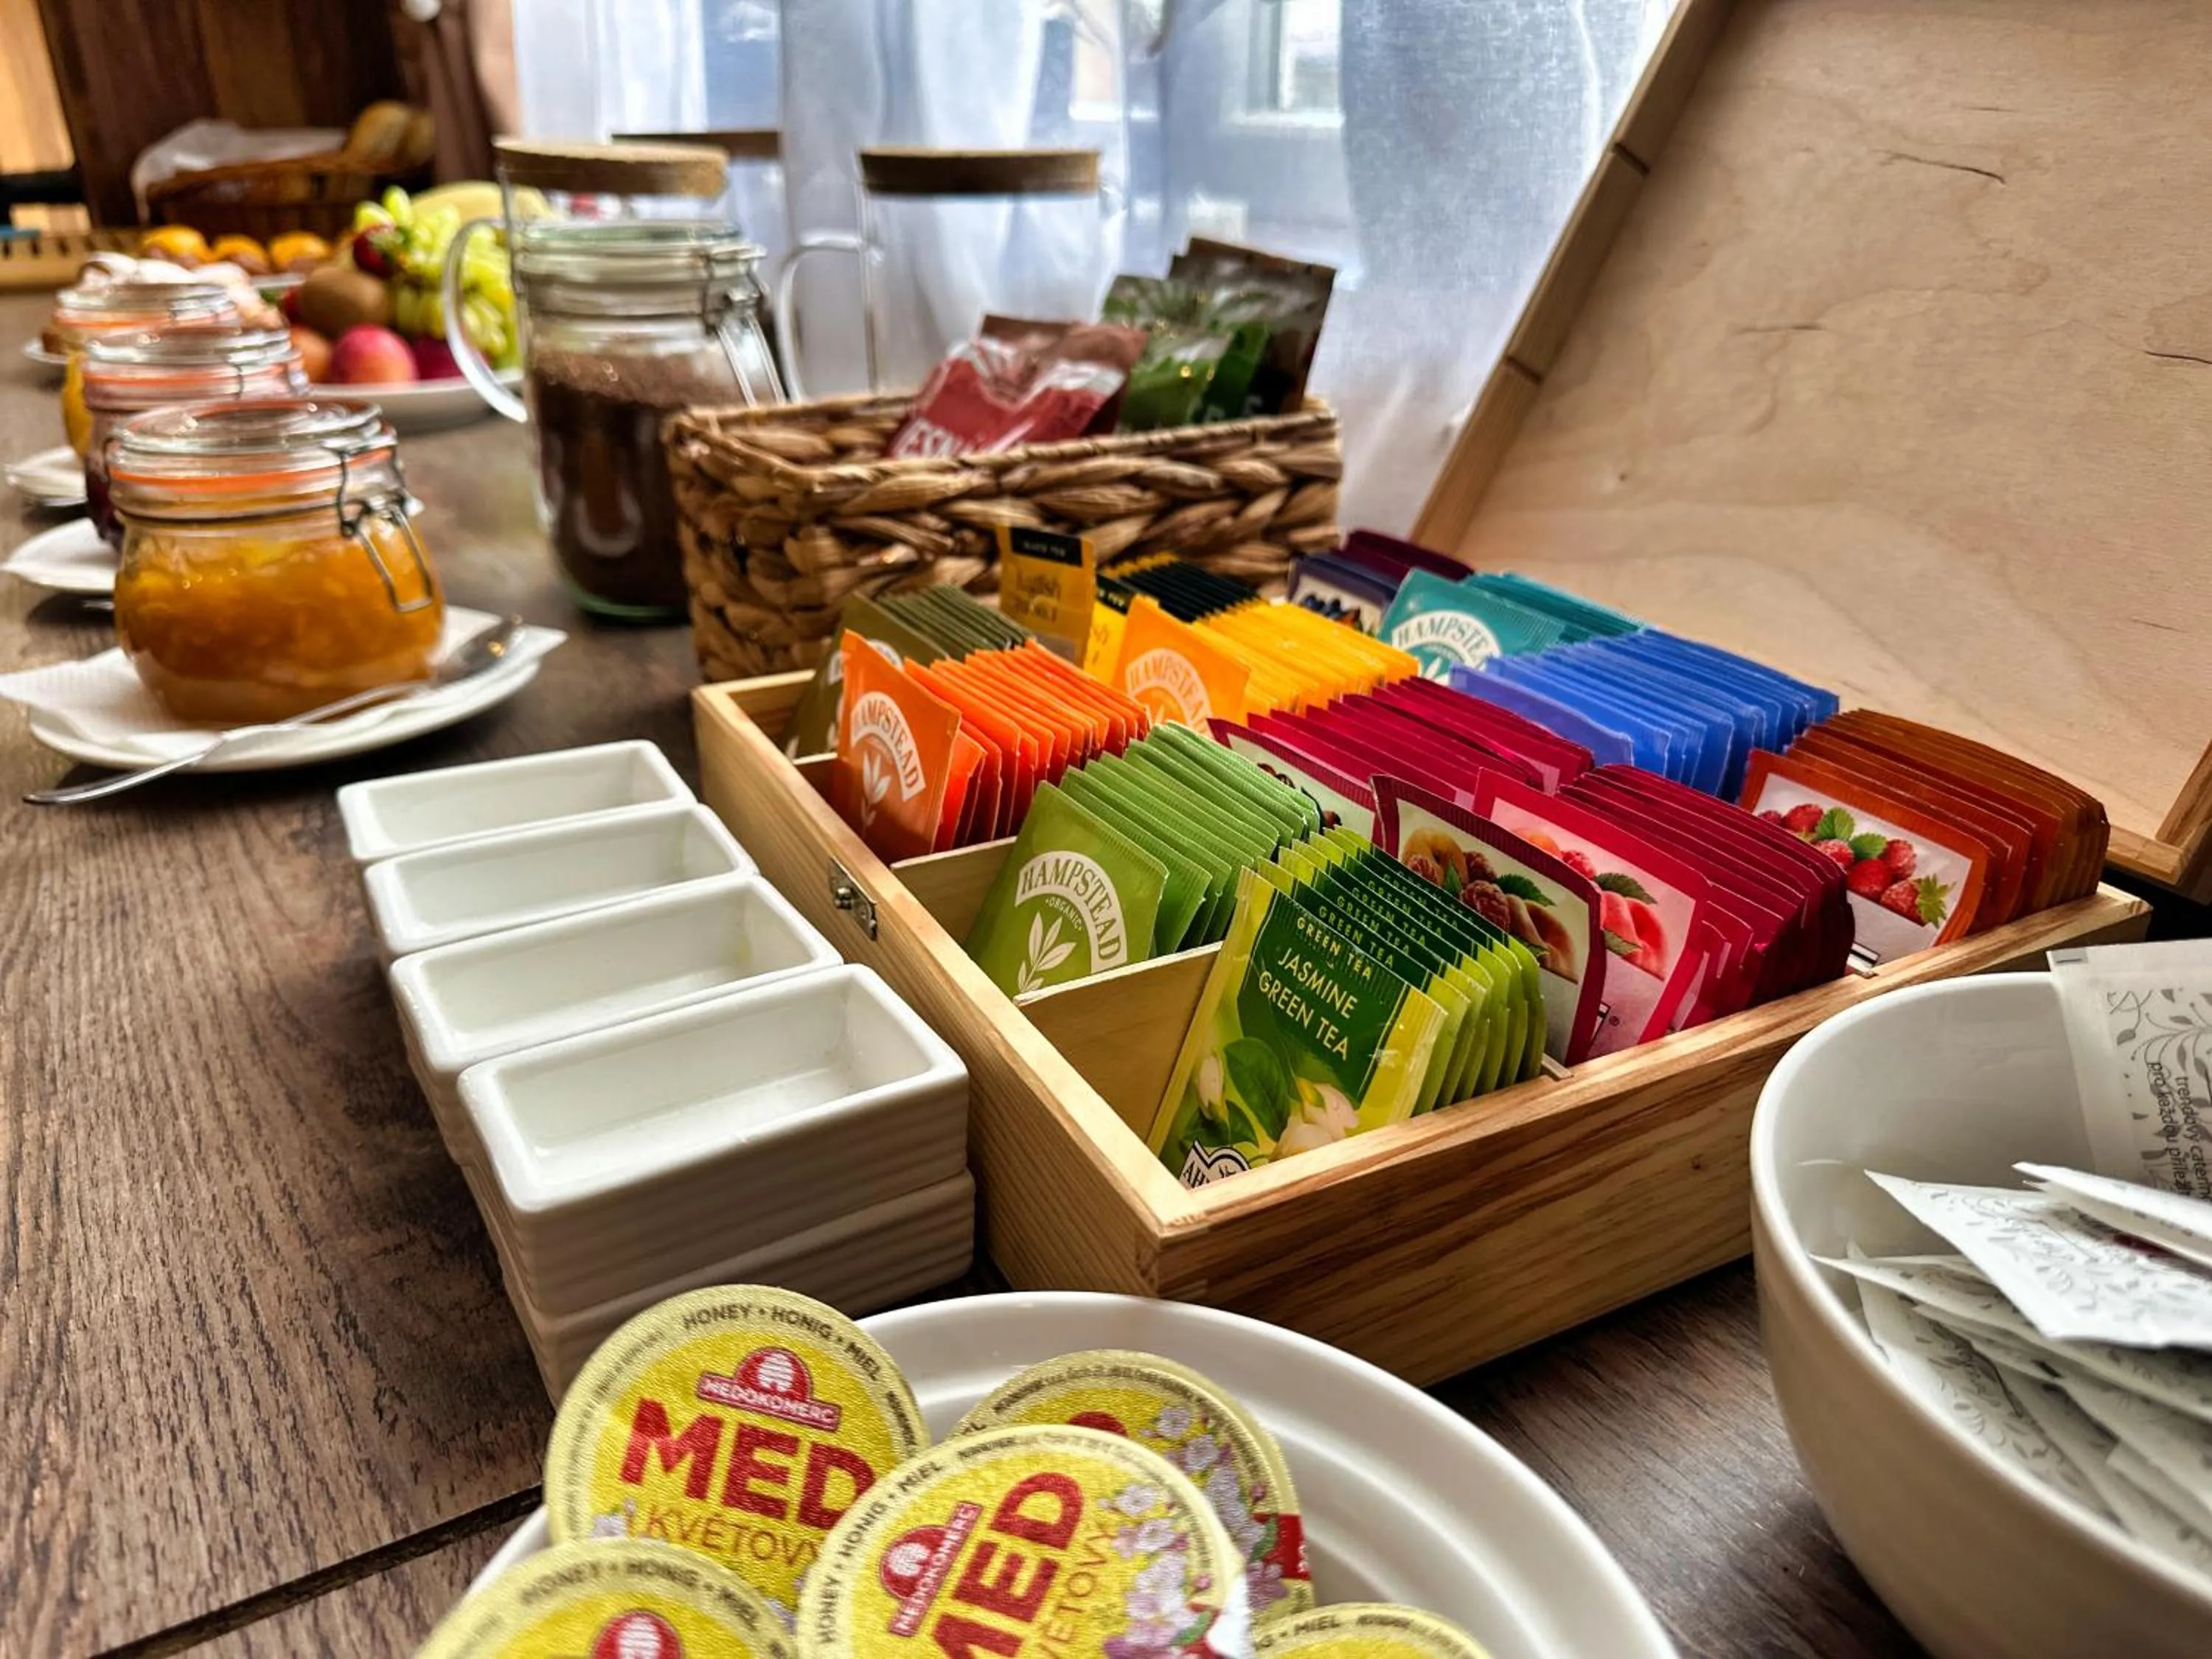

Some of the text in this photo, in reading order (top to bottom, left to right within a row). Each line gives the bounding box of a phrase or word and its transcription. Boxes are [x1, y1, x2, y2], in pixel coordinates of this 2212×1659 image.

[1397, 616, 1490, 668] HAMPSTEA
[1020, 858, 1121, 961] HAMPSTEAD
[1047, 895, 1082, 931] ORGANIC
[1318, 905, 1394, 967] GREEN TEA
[1337, 895, 1410, 956] GREEN TEA
[1352, 886, 1395, 923] GREEN
[1402, 922, 1426, 945] TEA
[1419, 914, 1442, 937] TEA
[1297, 917, 1372, 981] GREEN TEA
[1278, 947, 1358, 1020] JASMINE
[1259, 971, 1349, 1061] GREEN TEA
[2146, 1062, 2168, 1087] pro
[2156, 1091, 2179, 1144] každou
[682, 1304, 883, 1382] HONEY HONIG MIEL
[619, 1397, 877, 1531] MED
[815, 1574, 842, 1644] HONEY
[838, 1500, 888, 1558] HONIG
[894, 1460, 943, 1493] MIEL
[1293, 1615, 1341, 1637] MIEL
